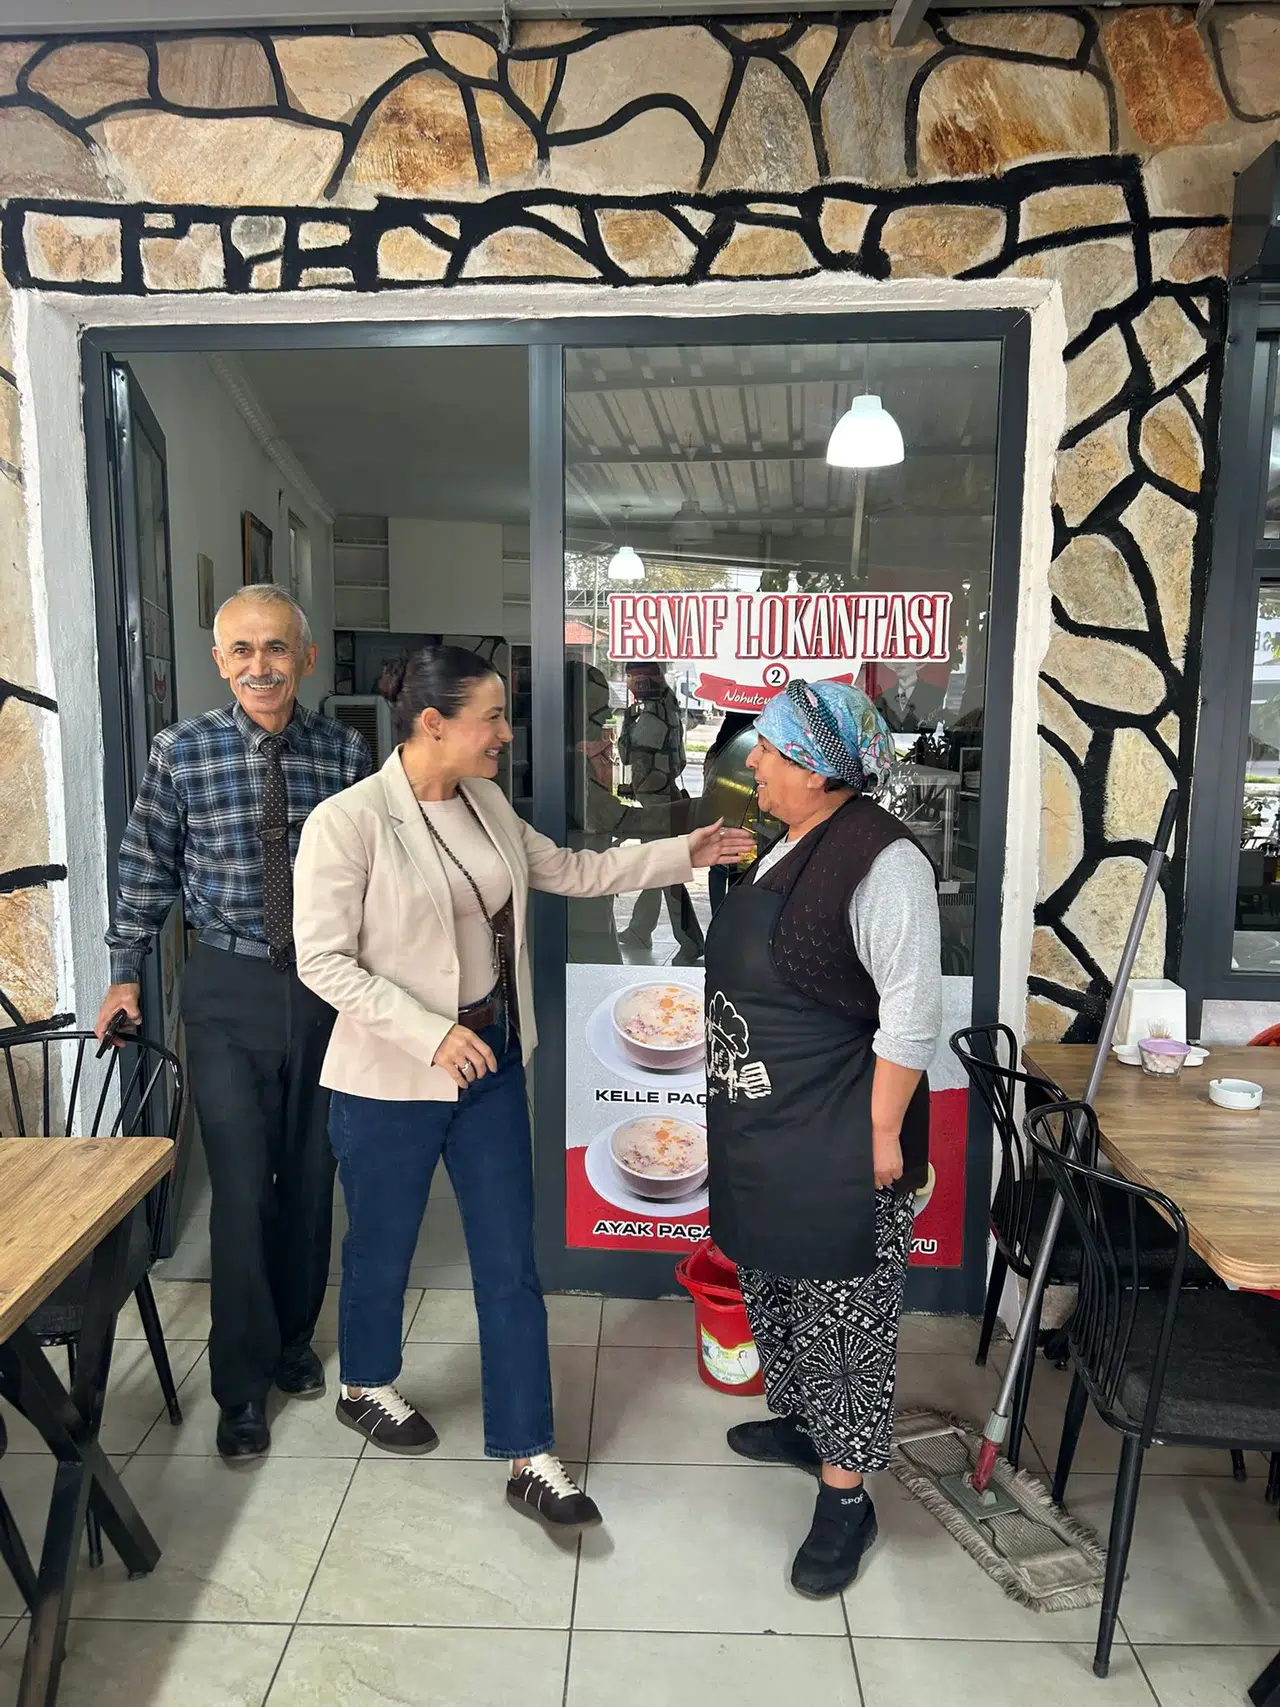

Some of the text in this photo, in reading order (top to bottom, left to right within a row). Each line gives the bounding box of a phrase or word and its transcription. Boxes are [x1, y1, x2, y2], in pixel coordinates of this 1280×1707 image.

[610, 595, 950, 660] ESNAF LOKANTASI
[771, 669, 781, 684] 2
[595, 1089, 660, 1103] KELLE
[594, 1221, 653, 1236] AYAK
